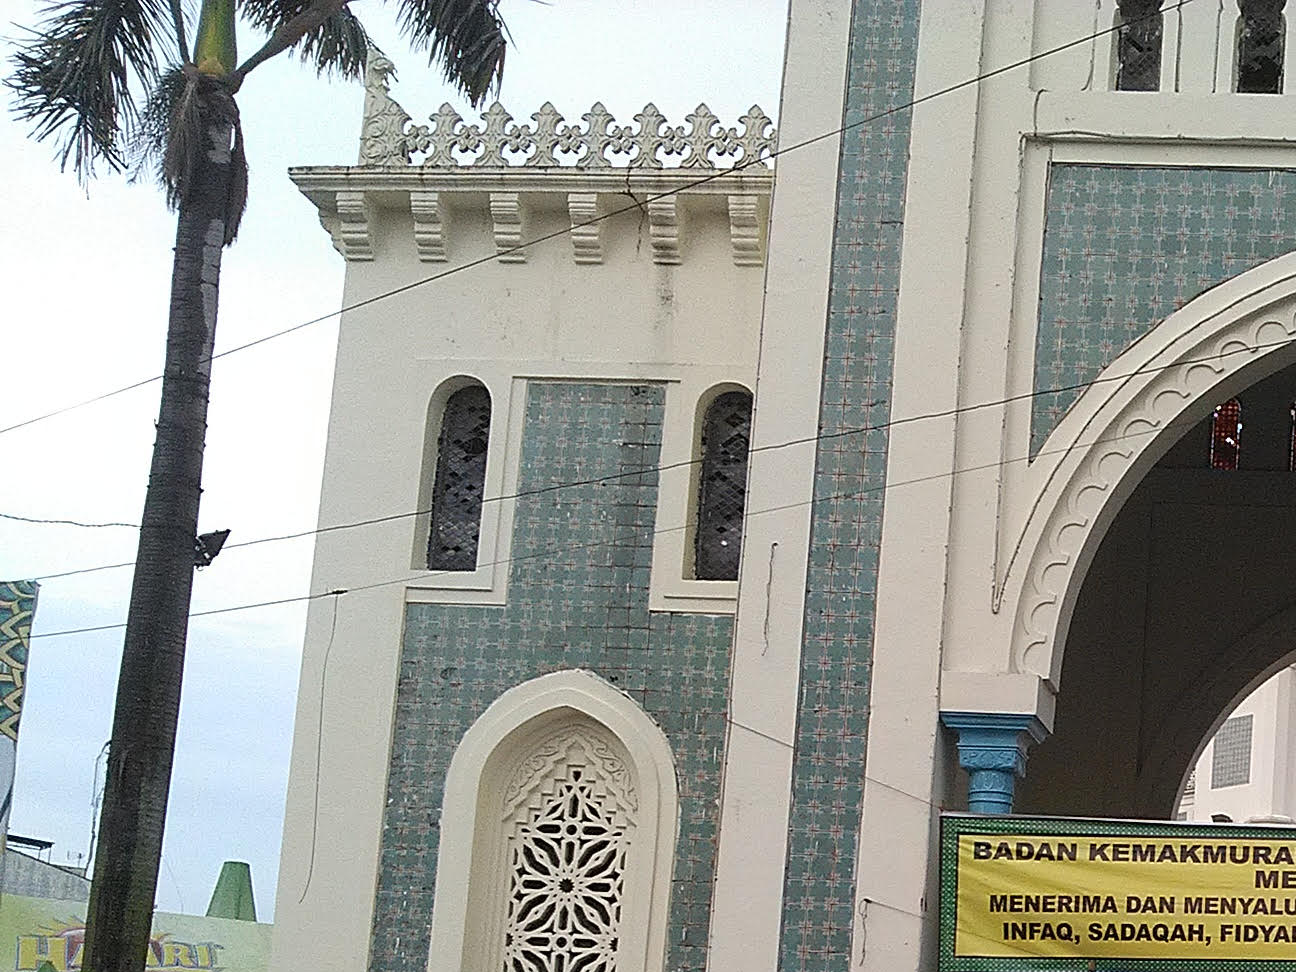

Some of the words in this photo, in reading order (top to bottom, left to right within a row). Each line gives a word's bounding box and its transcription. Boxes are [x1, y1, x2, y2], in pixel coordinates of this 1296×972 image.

[973, 841, 1077, 862] BADAN
[989, 894, 1117, 914] MENERIMA
[1126, 896, 1175, 914] DAN
[1002, 922, 1081, 944] INFAQ,
[1088, 924, 1212, 946] SADAQAH,
